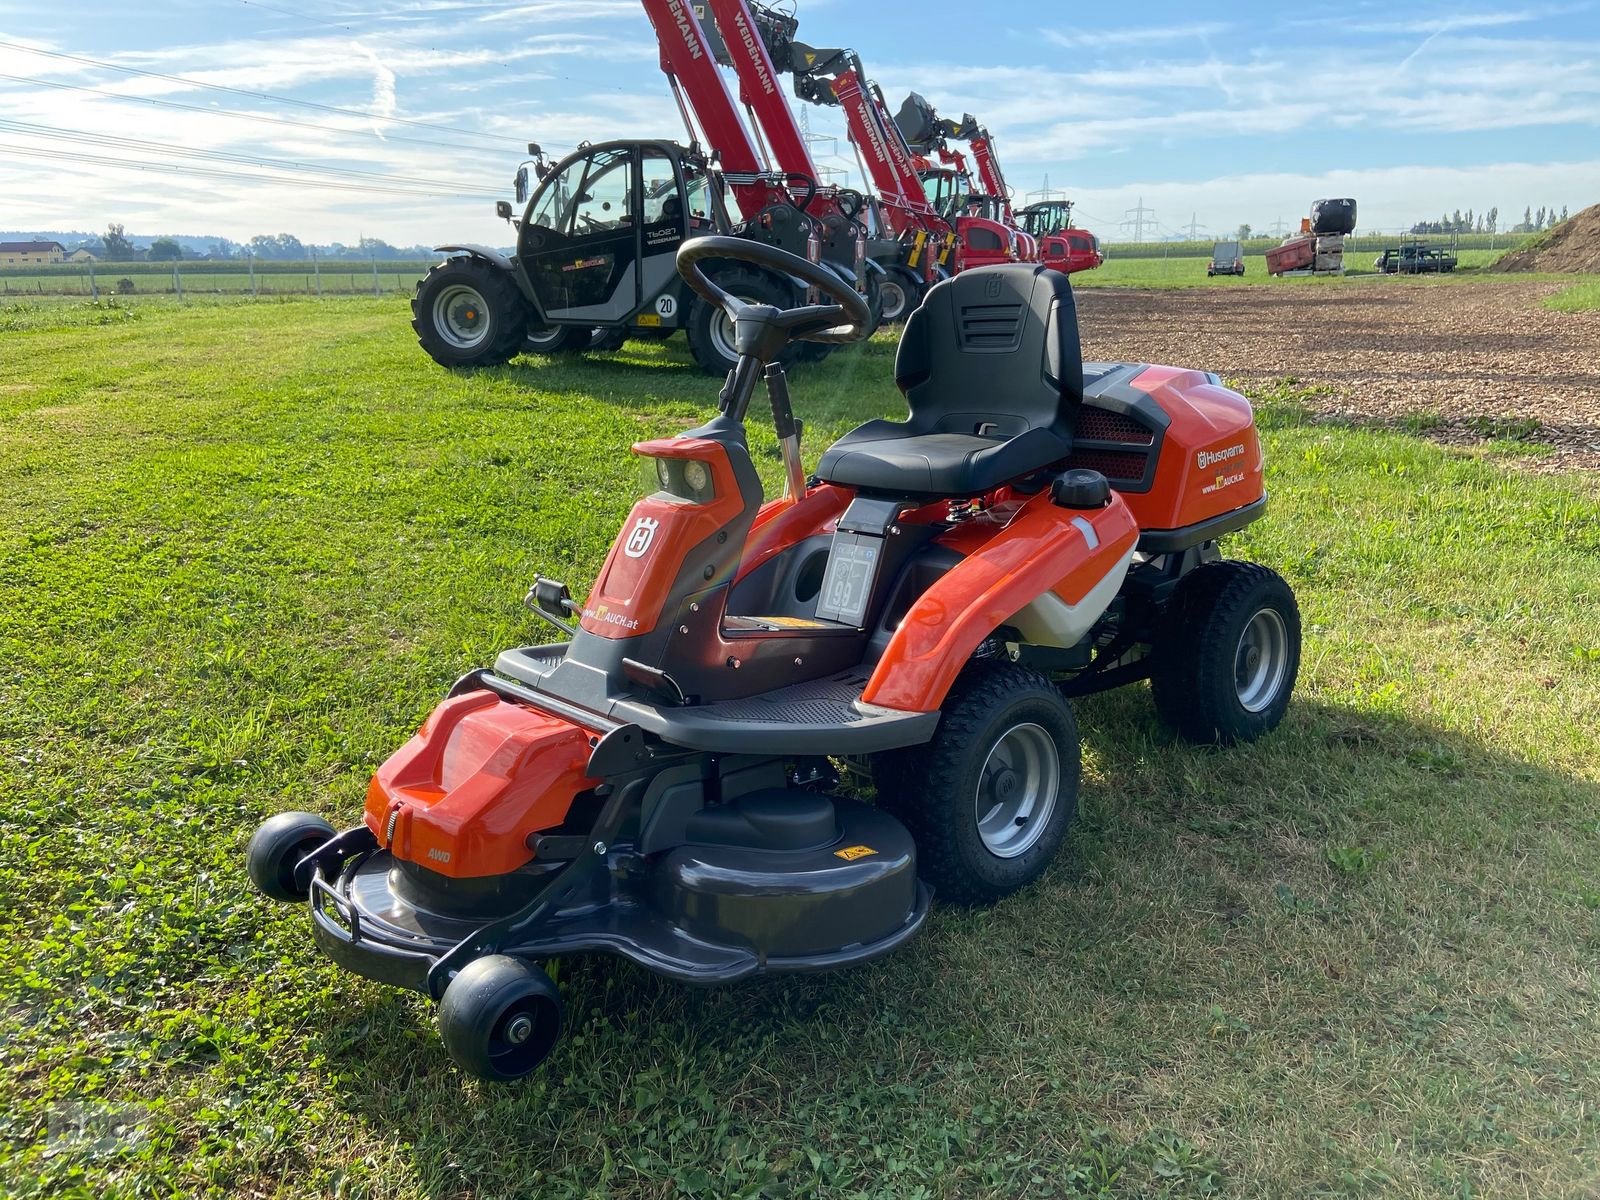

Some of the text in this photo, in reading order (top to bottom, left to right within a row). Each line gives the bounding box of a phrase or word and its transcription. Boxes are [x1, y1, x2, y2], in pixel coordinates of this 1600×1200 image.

[734, 12, 774, 94] WEIDEMANN
[857, 103, 885, 162] WEIDEMANN
[661, 299, 672, 313] 20
[1206, 444, 1244, 464] Husqvarna
[428, 848, 450, 863] AWD
